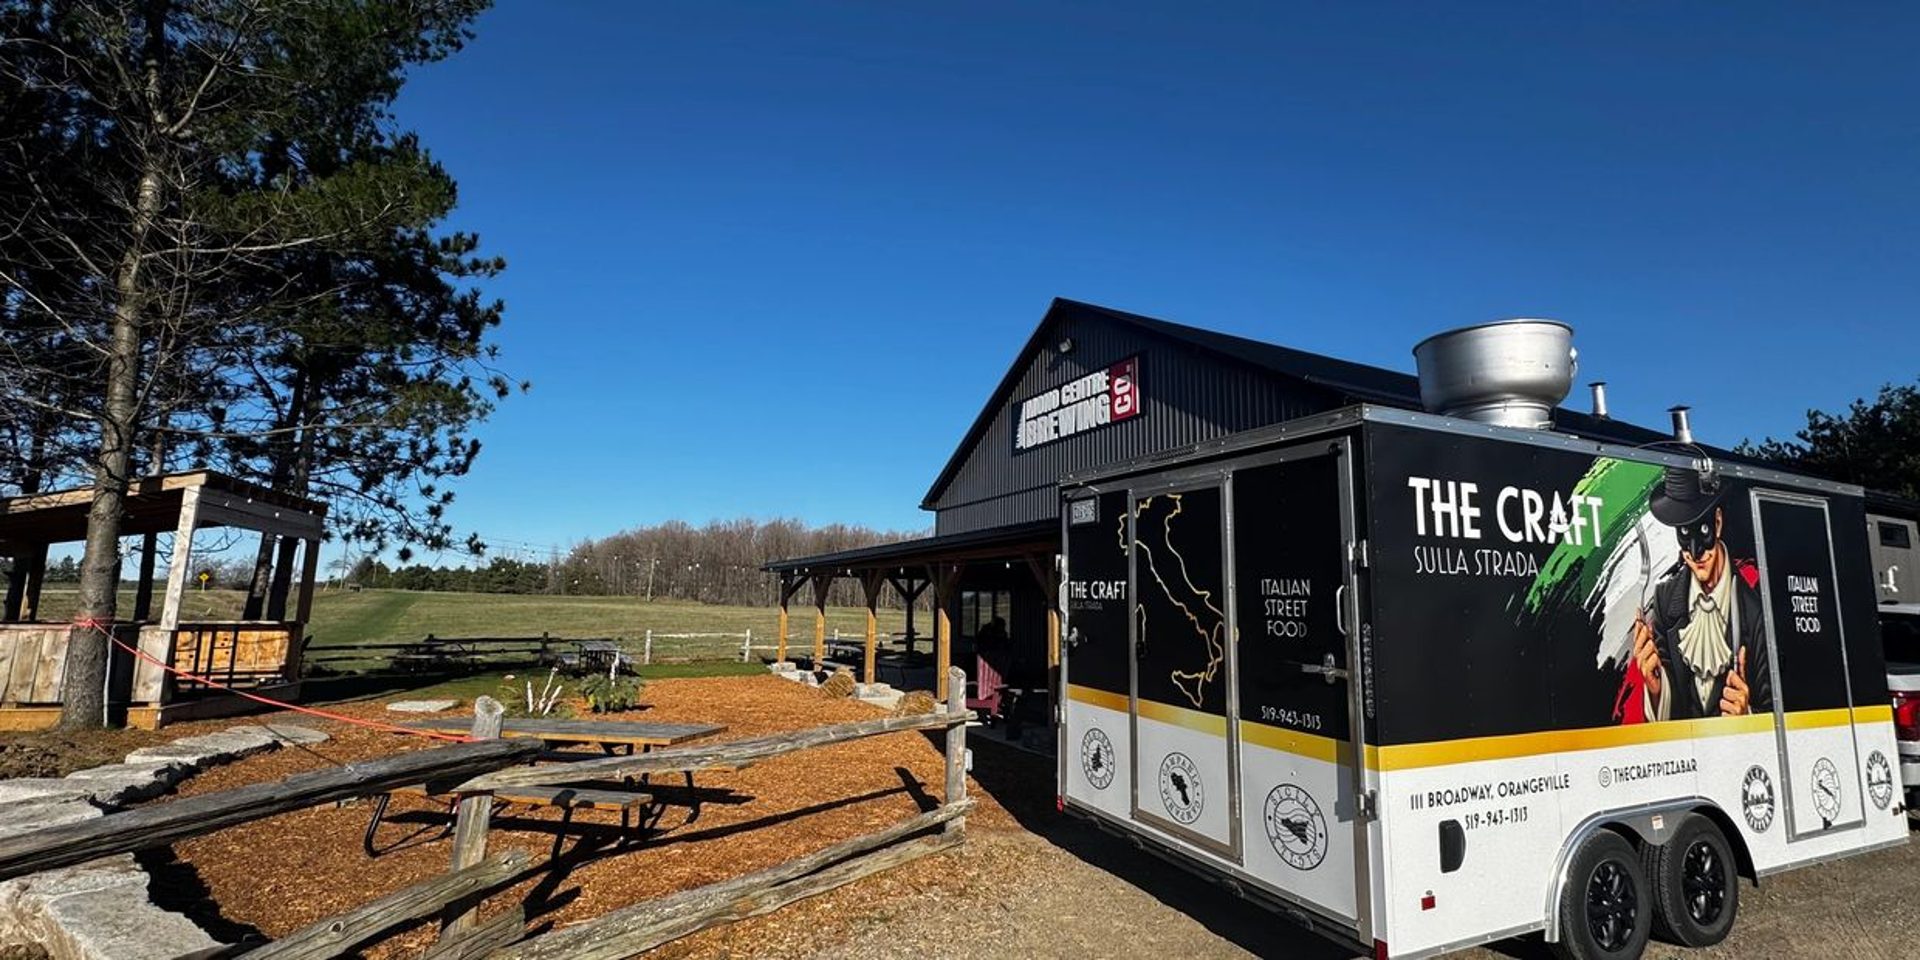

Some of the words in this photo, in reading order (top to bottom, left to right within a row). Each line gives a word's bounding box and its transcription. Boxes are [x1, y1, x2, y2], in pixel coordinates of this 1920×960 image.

[1061, 368, 1110, 405] CENTRE
[1026, 394, 1110, 448] BREWING
[1408, 476, 1482, 540] THE
[1496, 485, 1603, 548] CRAFT
[1414, 545, 1470, 575] SULLA
[1475, 549, 1539, 577] STRADA
[1070, 581, 1087, 599] THE
[1090, 581, 1127, 600] CRAFT
[1261, 578, 1311, 596] ITALIAN
[1788, 575, 1819, 593] ITALIAN
[1264, 600, 1307, 617] STREET
[1791, 596, 1818, 613] STREET
[1267, 620, 1307, 637] FOOD
[1795, 616, 1821, 632] FOOD
[1261, 705, 1322, 730] 519-943-1313
[1613, 757, 1698, 784] THECRAFTPIZZABAR
[1428, 783, 1494, 808] BROADWAY,
[1497, 773, 1570, 798] ORANGEVILLE
[1464, 806, 1529, 831] 519-943-1313
